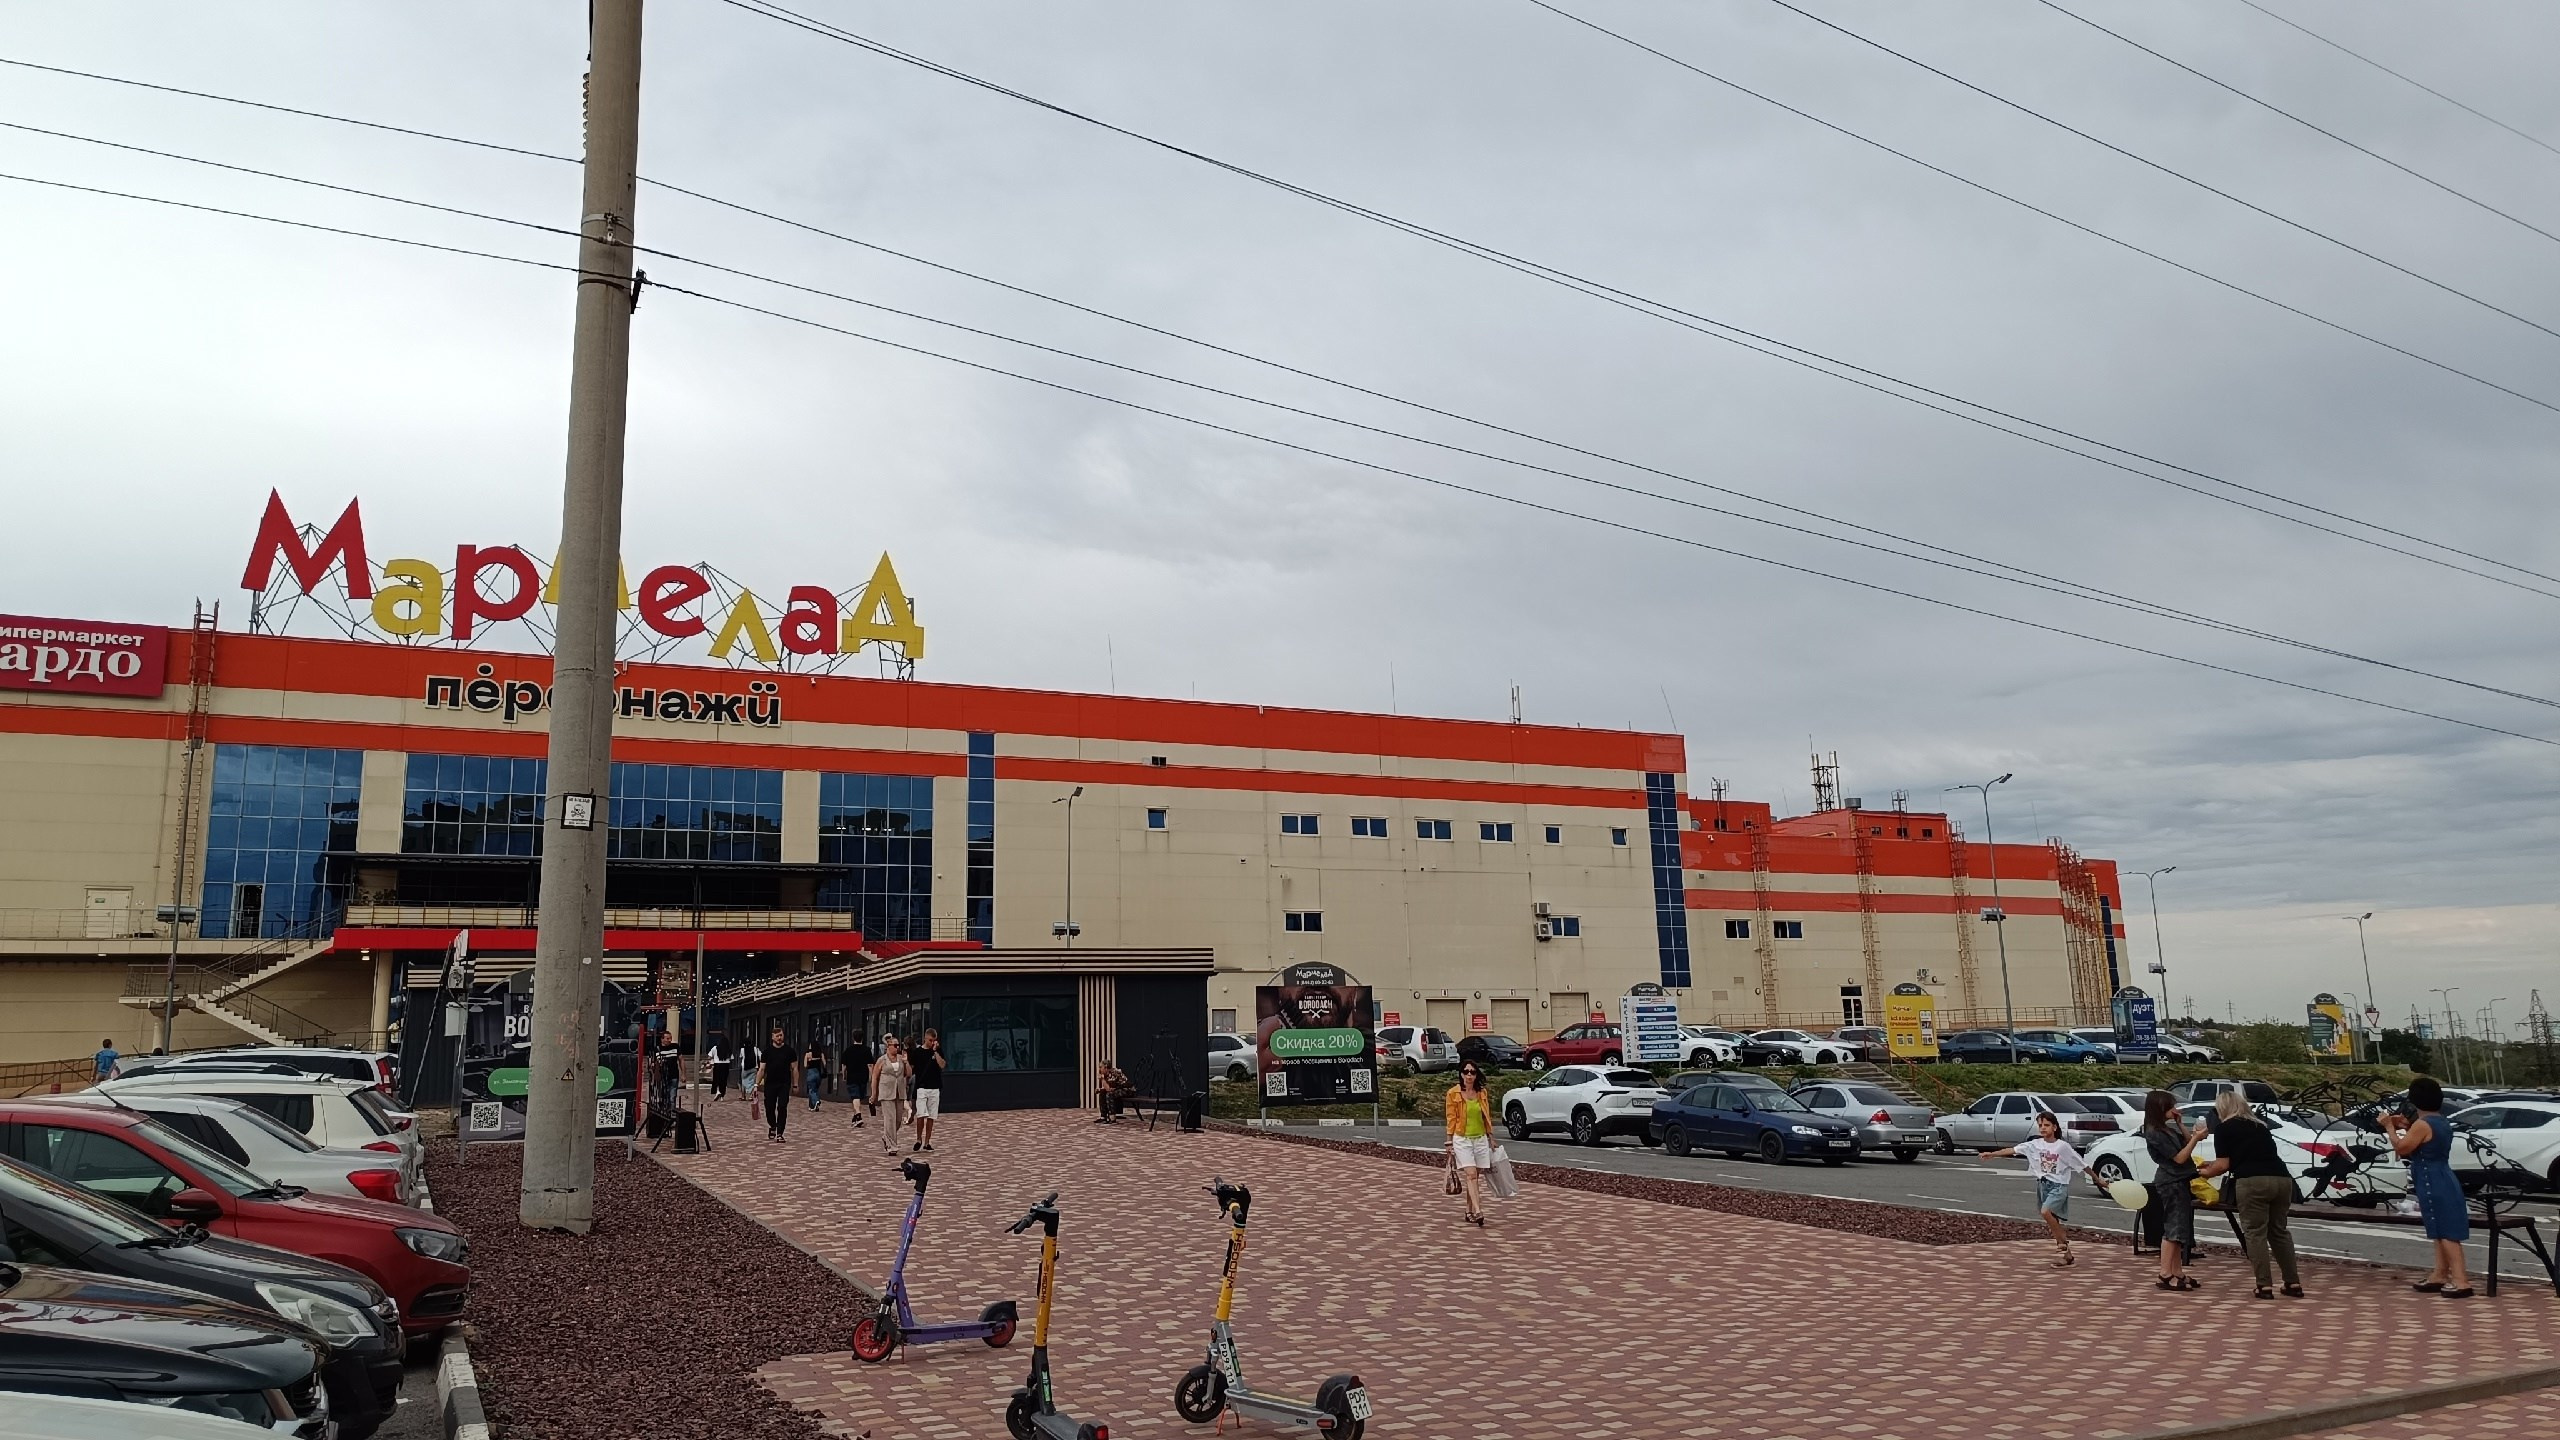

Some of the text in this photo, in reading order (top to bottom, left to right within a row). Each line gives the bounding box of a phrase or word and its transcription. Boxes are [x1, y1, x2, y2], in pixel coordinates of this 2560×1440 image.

[0, 643, 142, 683] ардо
[1298, 1000, 1333, 1010] BORODACH
[1276, 1034, 1358, 1052] Скидка 20%
[1225, 1232, 1244, 1289] WHOOSH
[1352, 1403, 1370, 1418] 311
